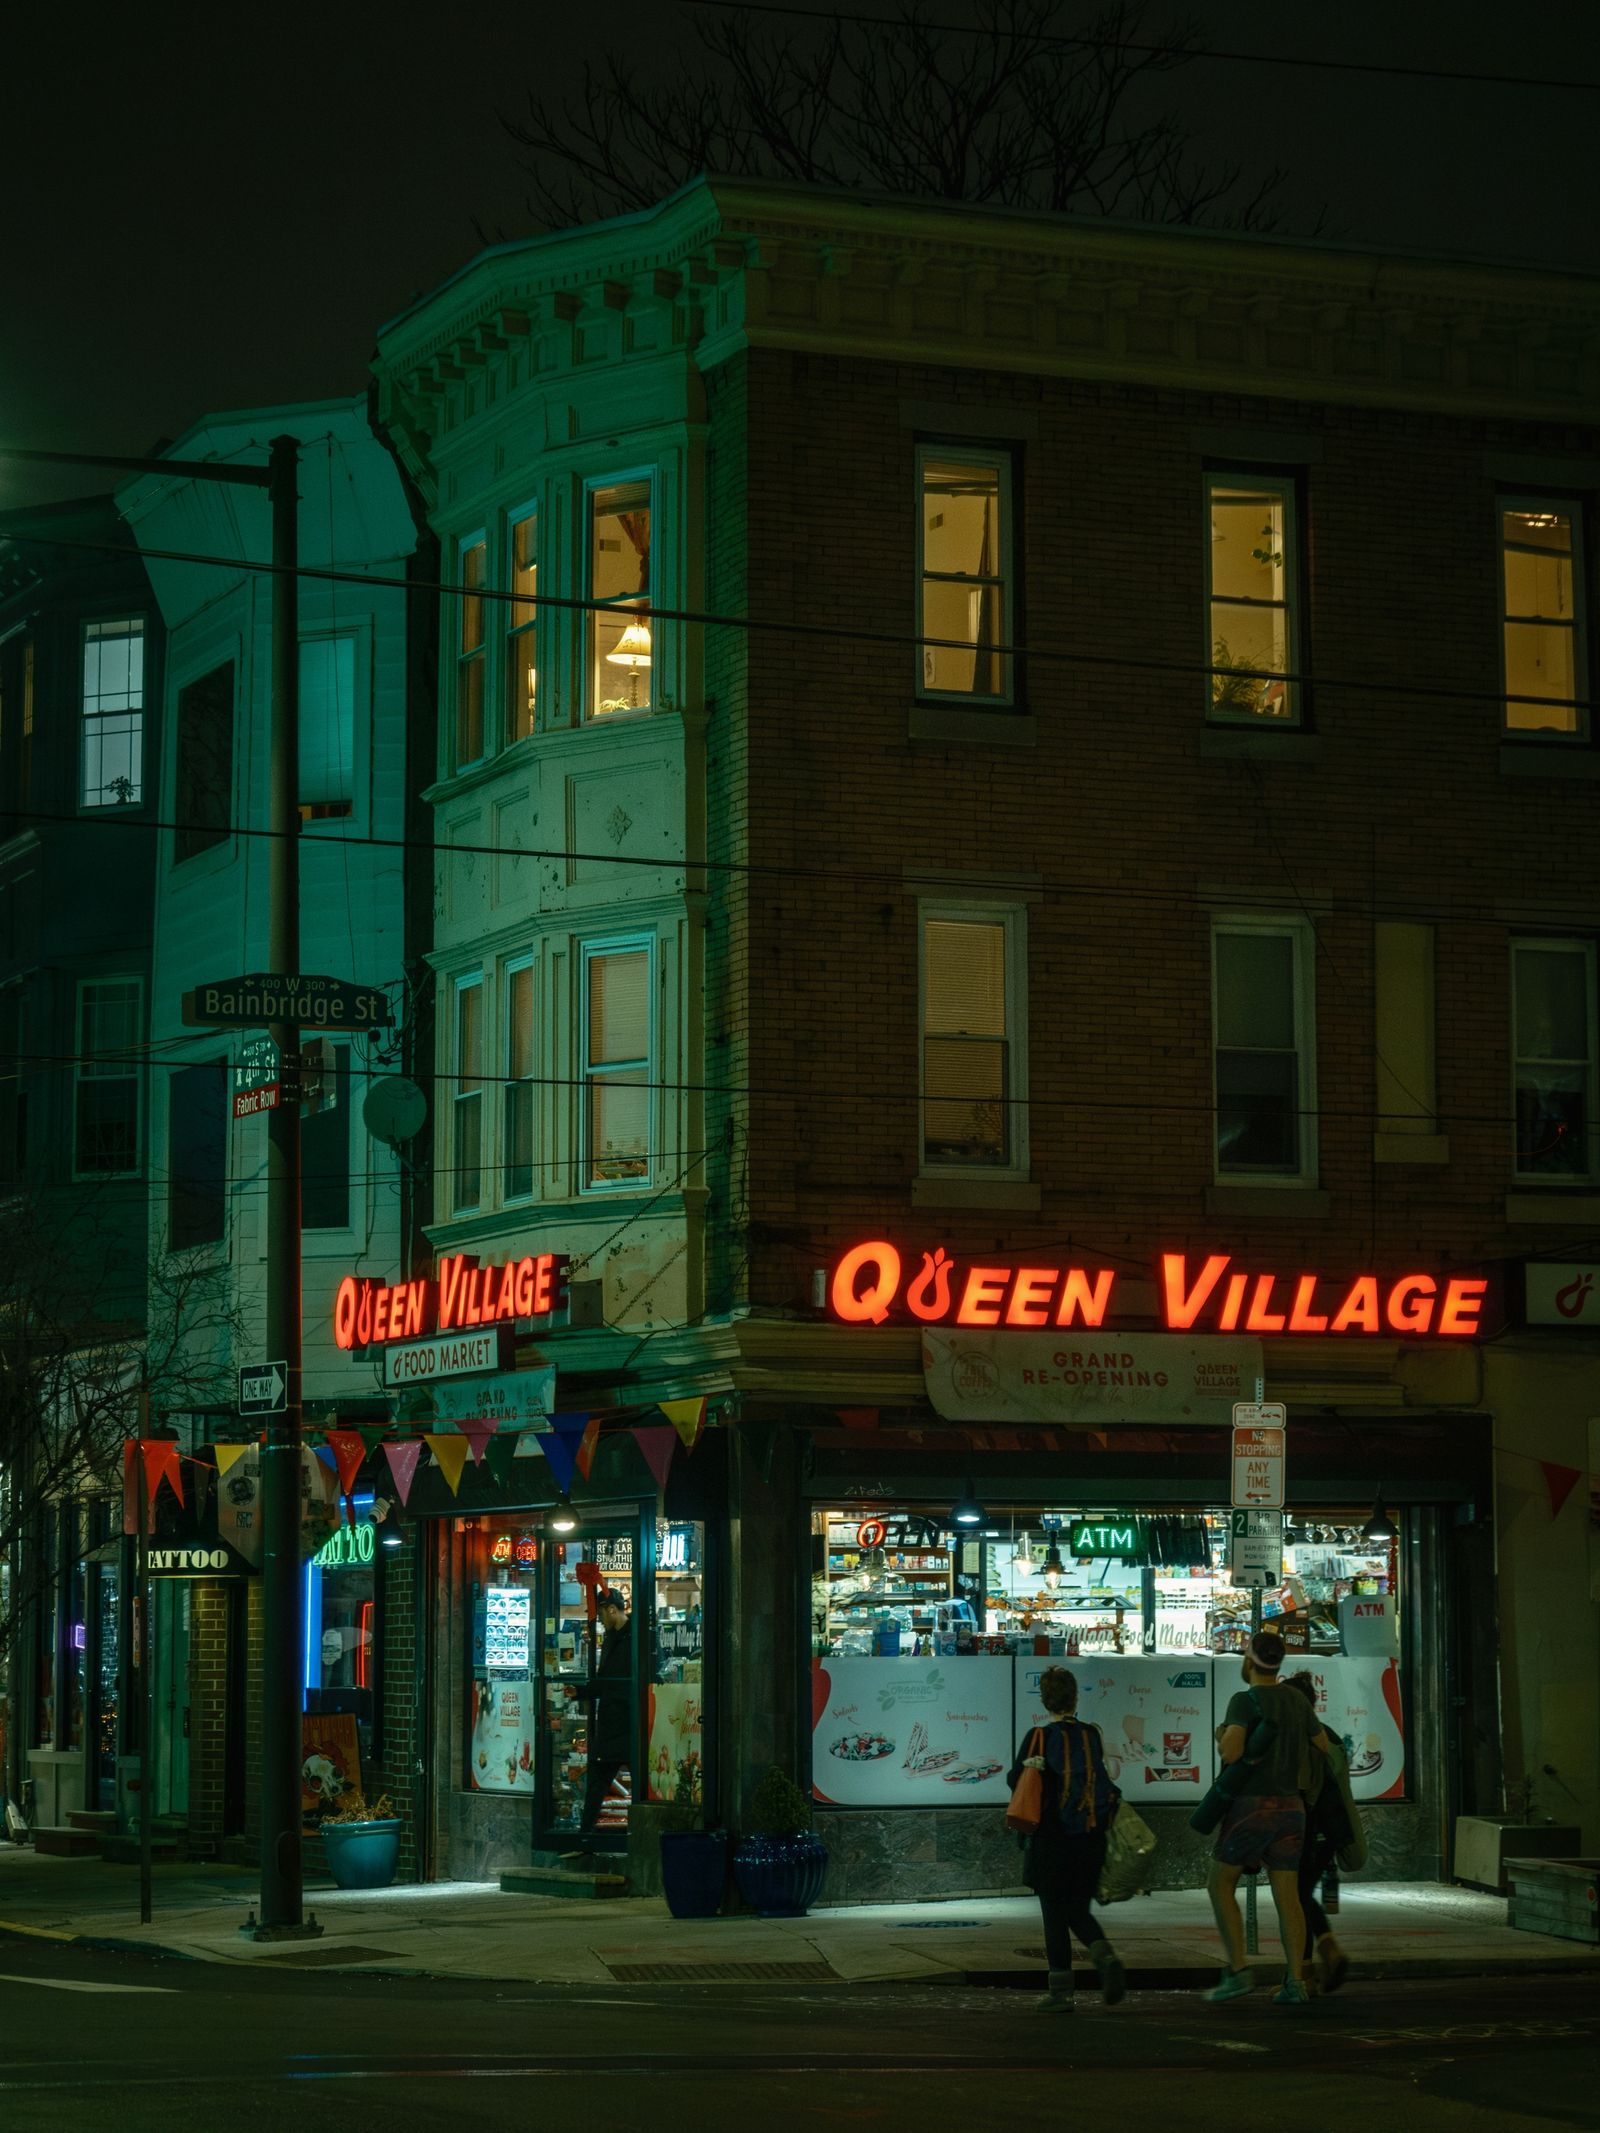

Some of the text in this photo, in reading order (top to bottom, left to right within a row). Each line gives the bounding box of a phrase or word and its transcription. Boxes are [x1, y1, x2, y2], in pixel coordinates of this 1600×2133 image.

[259, 978, 325, 991] 400 W 300
[204, 989, 378, 1025] Bainbridge St
[264, 1053, 276, 1082] St
[236, 1089, 276, 1116] Fabric Row
[439, 1253, 555, 1329] VILLAGE
[1162, 1254, 1489, 1335] VILLAGE
[404, 1338, 491, 1378] FOOD MARKET
[1053, 1352, 1135, 1369] GRAND
[1022, 1369, 1170, 1388] RE-OPENING
[1193, 1376, 1241, 1387] VILLAGE
[244, 1379, 273, 1399] ONE WAY
[1251, 1430, 1265, 1442] NO
[1235, 1444, 1282, 1456] STOPPING
[1247, 1461, 1269, 1474] ANY
[1246, 1475, 1271, 1489] TIME
[856, 1517, 944, 1548] OPEN
[1235, 1513, 1246, 1534] 2
[1248, 1525, 1281, 1536] PARKING
[1077, 1529, 1133, 1549] ATM
[516, 1546, 537, 1561] OPEN
[1354, 1603, 1385, 1617] ATM
